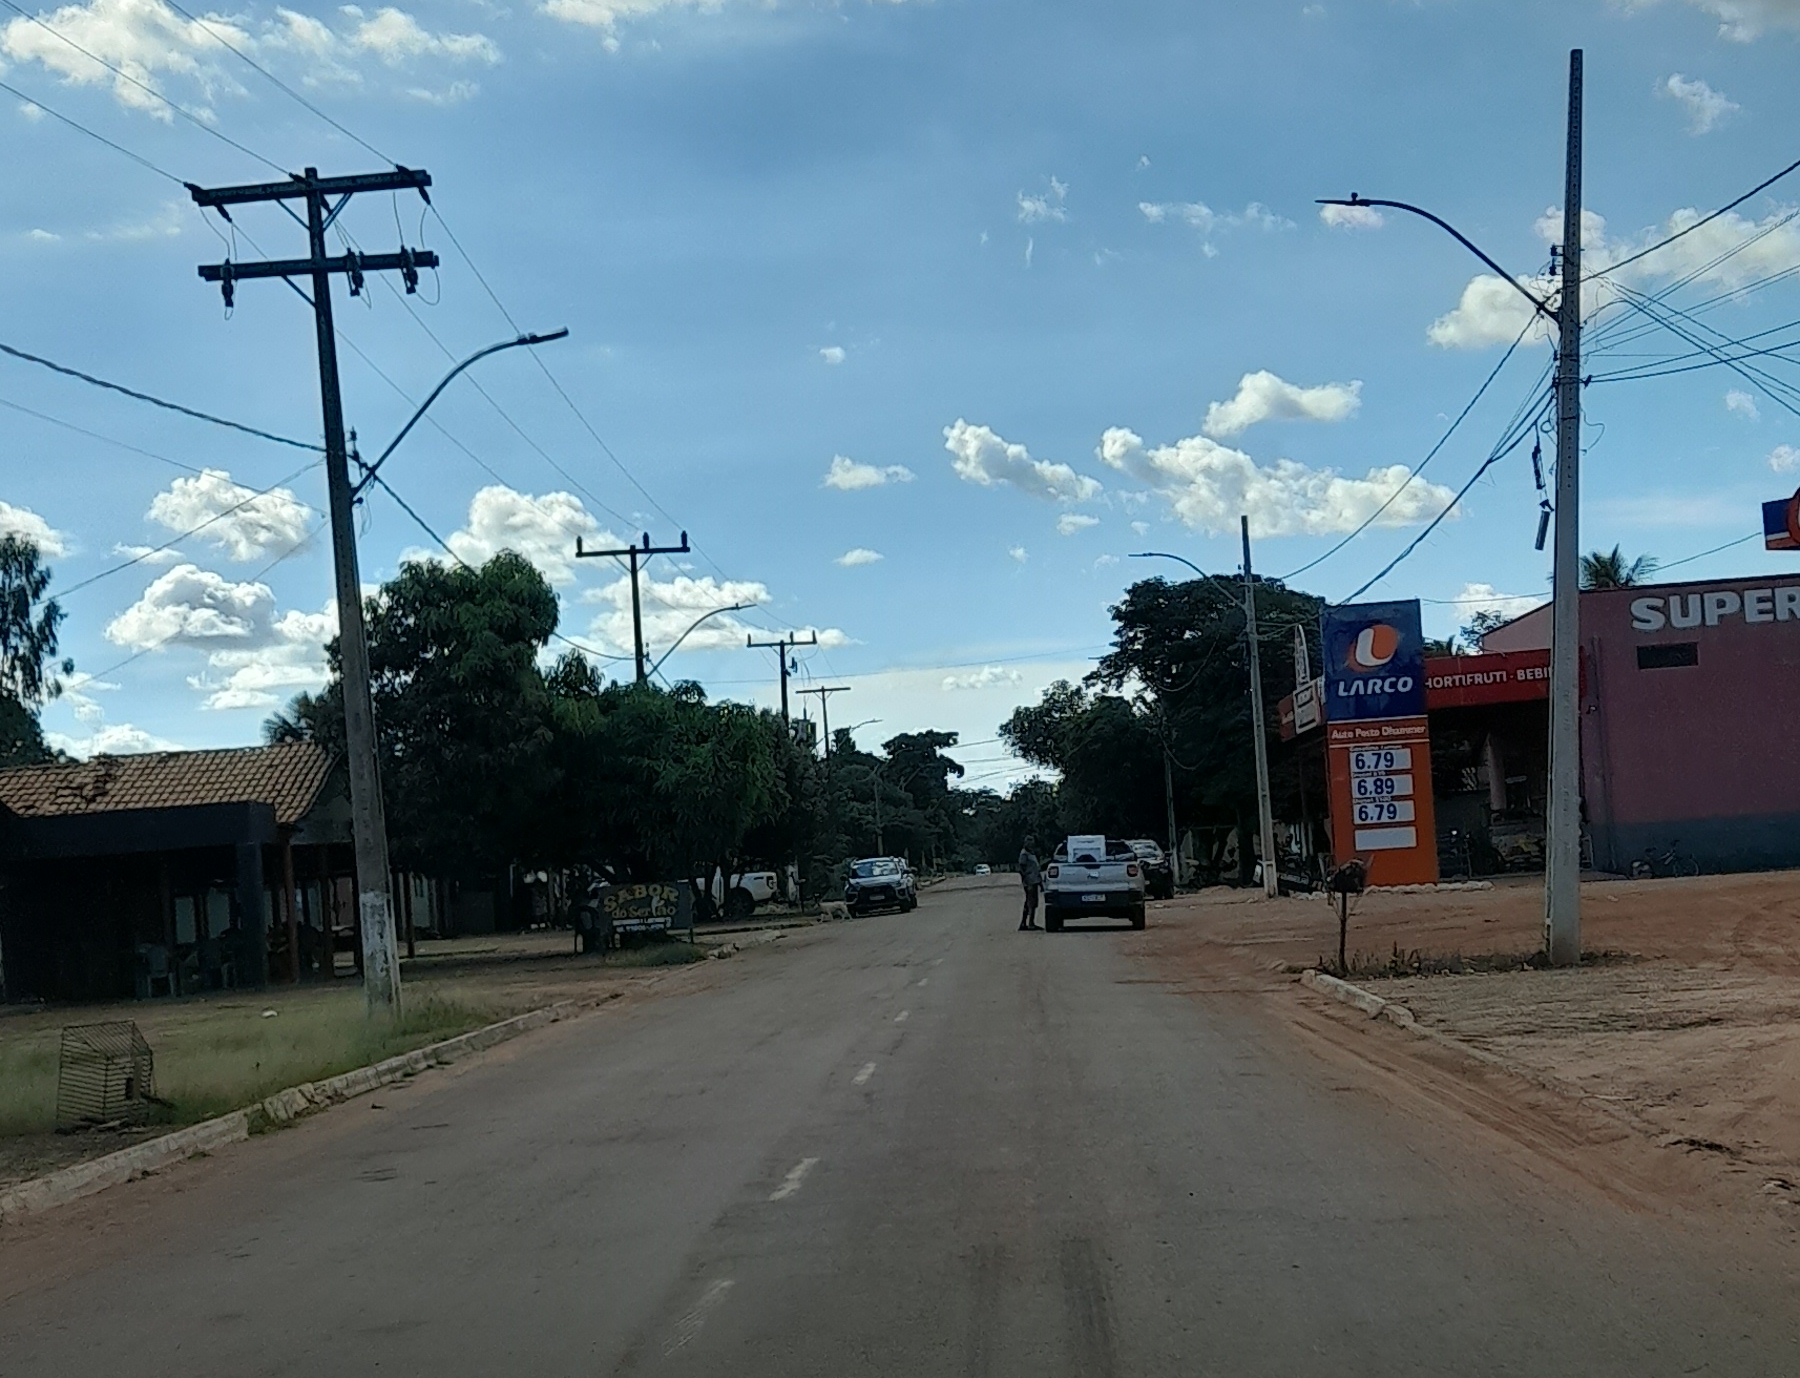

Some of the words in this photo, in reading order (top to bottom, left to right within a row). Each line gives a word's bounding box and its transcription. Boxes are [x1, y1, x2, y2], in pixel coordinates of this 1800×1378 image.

[1630, 586, 1800, 630] SUPER
[1516, 666, 1551, 681] BEBI
[1338, 676, 1413, 696] LARCO
[1355, 728, 1380, 737] Posto
[1355, 752, 1394, 770] 6.79
[1358, 803, 1397, 822] 6.79
[604, 884, 679, 912] SABOR
